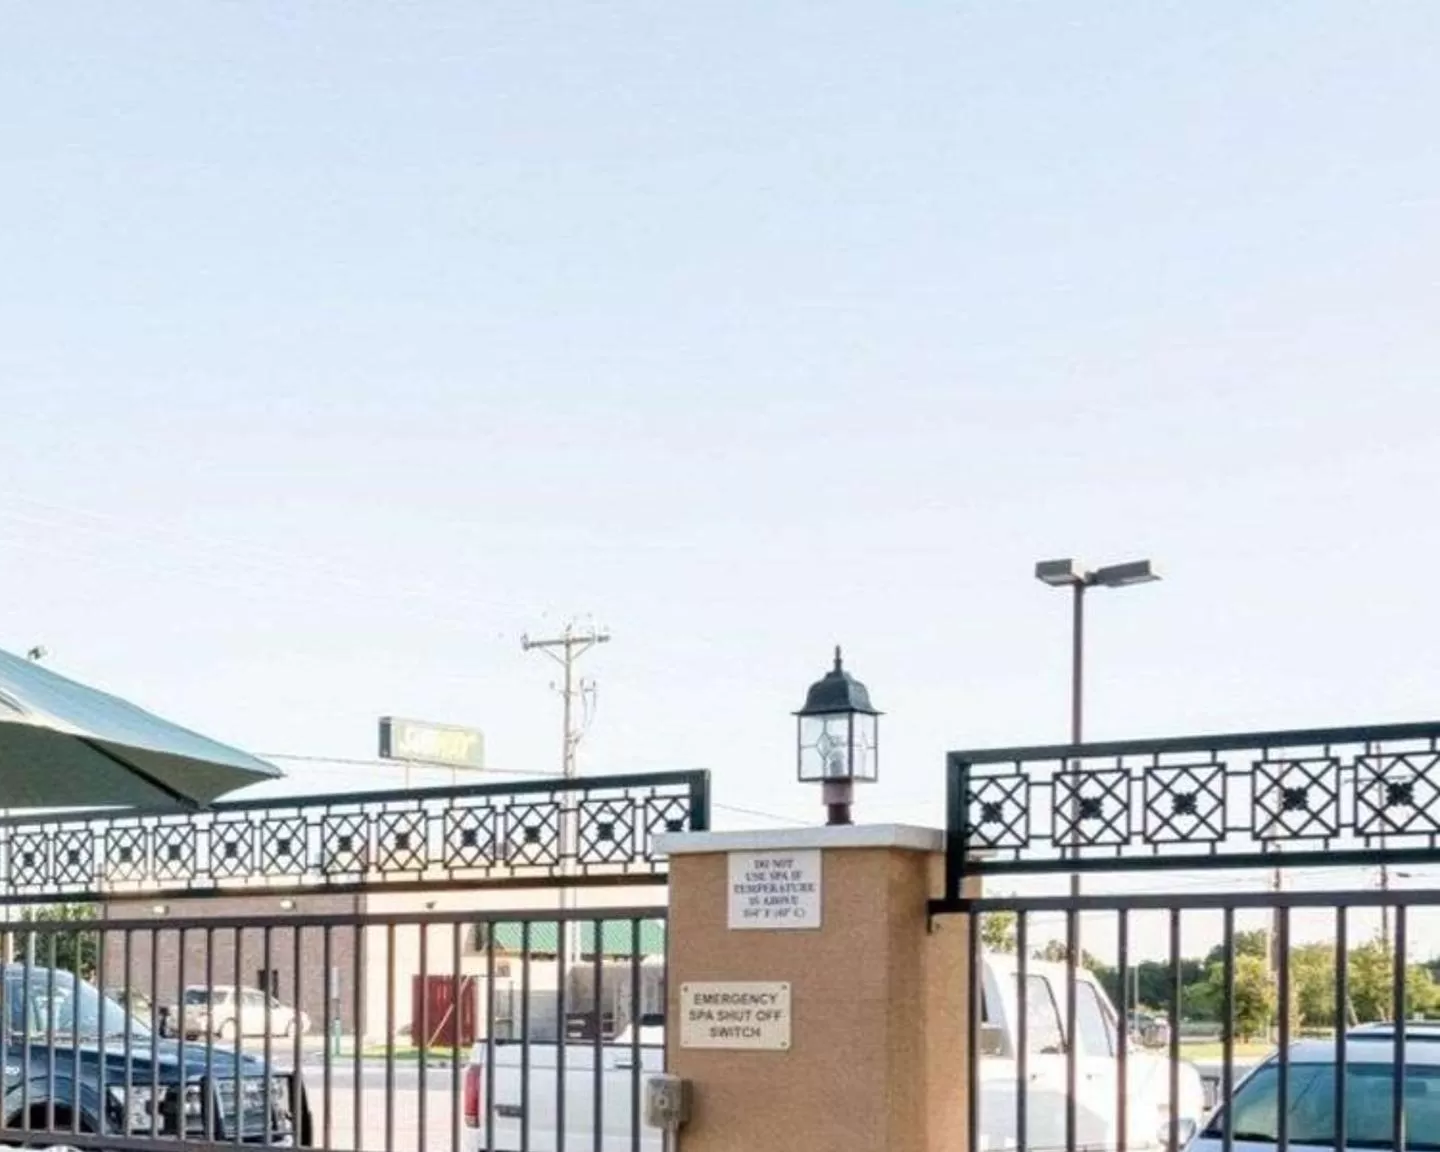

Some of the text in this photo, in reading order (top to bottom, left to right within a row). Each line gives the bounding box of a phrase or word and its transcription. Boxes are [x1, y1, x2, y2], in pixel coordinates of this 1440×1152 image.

[693, 993, 778, 1006] EMERGENCY
[688, 1009, 782, 1022] SPA SHUT OFF
[709, 1026, 762, 1038] SWITCH
